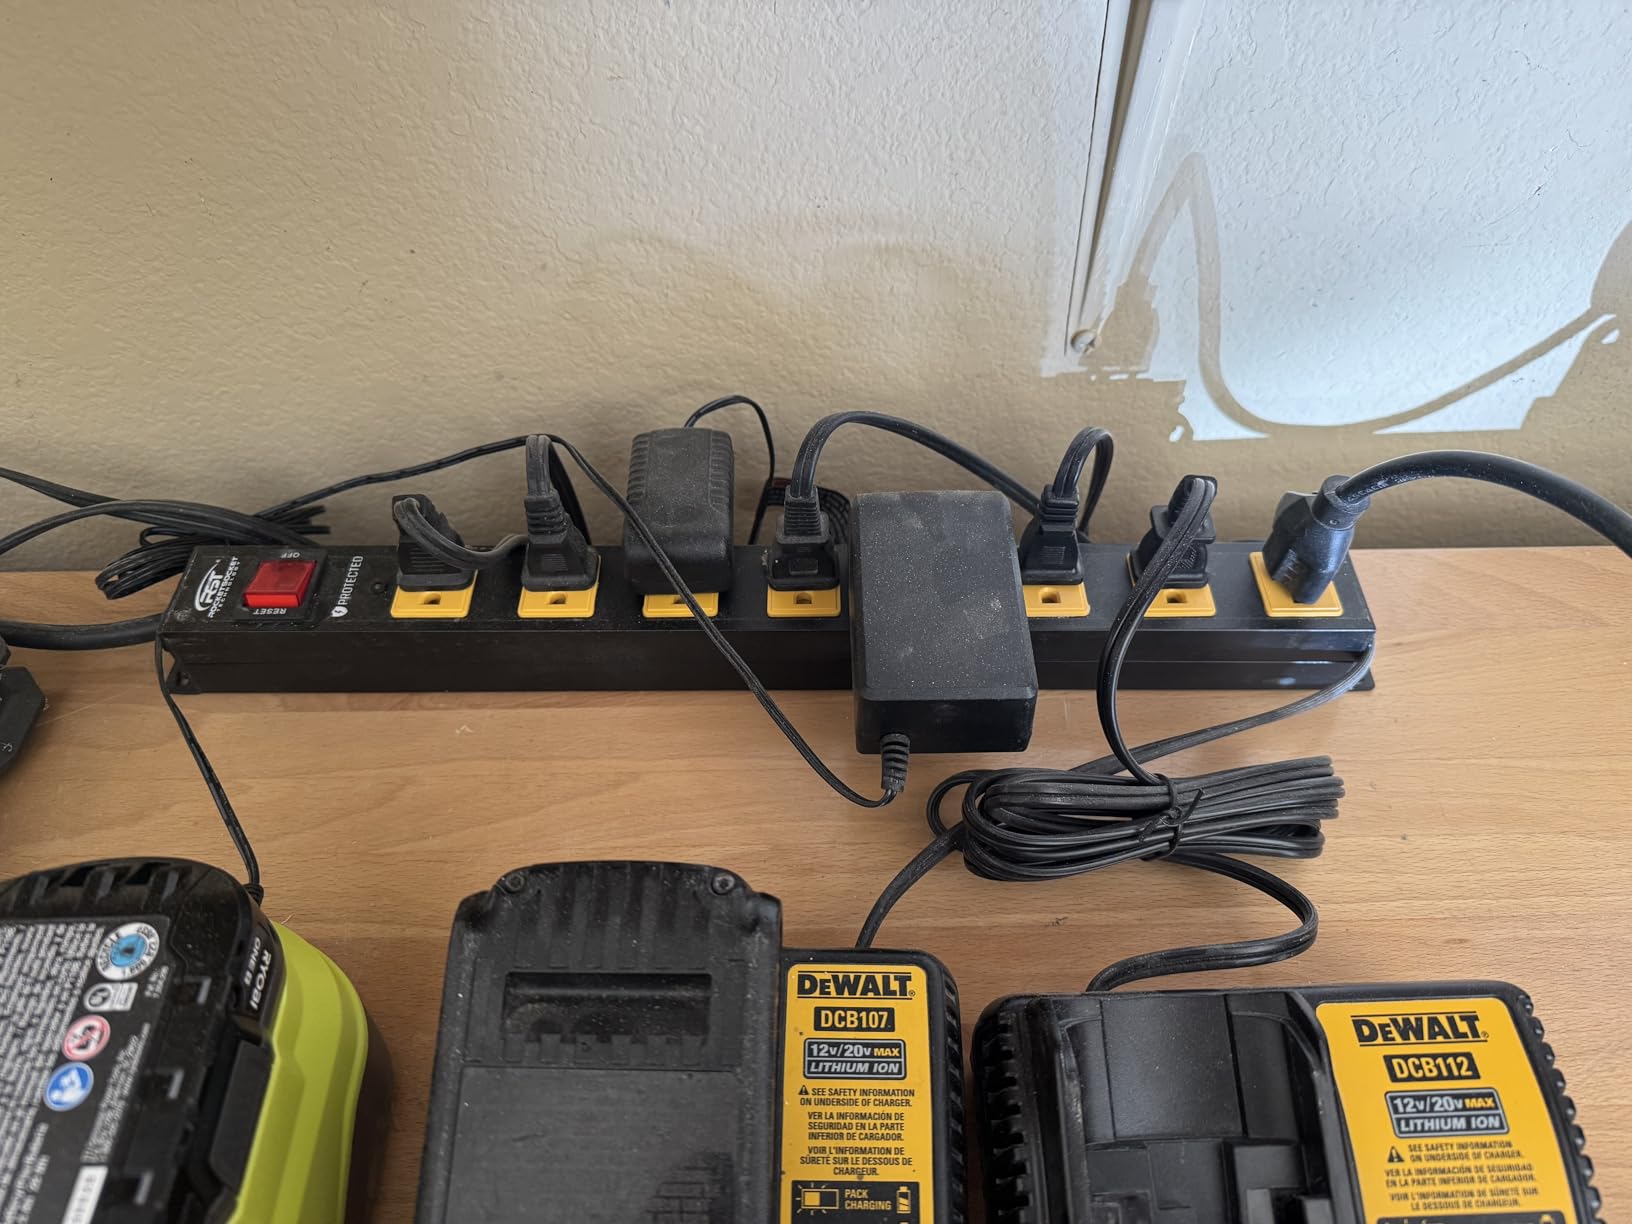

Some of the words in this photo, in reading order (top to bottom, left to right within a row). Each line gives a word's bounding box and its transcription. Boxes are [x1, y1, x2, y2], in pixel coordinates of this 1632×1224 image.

[338, 555, 363, 605] PROTECTED
[250, 950, 271, 1010] RYOBI
[820, 1010, 888, 1028] DCB107
[873, 1048, 899, 1056] MAX
[810, 1062, 869, 1073] LITHIUM
[873, 1063, 899, 1073] ION
[1391, 1056, 1472, 1079] DCB112
[812, 1088, 827, 1096] SEE
[828, 1088, 856, 1096] SAFETY
[800, 1098, 812, 1106] ON
[814, 1098, 859, 1106] UNDERSIDE
[874, 1099, 912, 1107] CHARGER.
[1464, 1097, 1495, 1109] MAX
[808, 1112, 822, 1120] VER
[825, 1112, 834, 1120] LA
[836, 1110, 892, 1120] INFORMACIÓN
[808, 1122, 853, 1130] SEGURIDAD
[880, 1123, 904, 1131] PARTE
[1400, 1116, 1466, 1132] LITHIUM
[1471, 1116, 1499, 1129] ION
[808, 1132, 844, 1140] INFERIOR
[859, 1133, 903, 1141] CARGADOR.
[808, 1146, 827, 1154] VOIR
[828, 1147, 892, 1155] L'INFORMATION
[800, 1154, 830, 1165] SÛRETÉ
[832, 1157, 848, 1165] SUR
[851, 1157, 860, 1165] LE
[862, 1157, 898, 1165] DESSOUS
[902, 1158, 912, 1166] DE
[833, 1167, 879, 1175] CHARGEUR.
[845, 1189, 868, 1198] PACK
[845, 1200, 892, 1210] CHARGING
